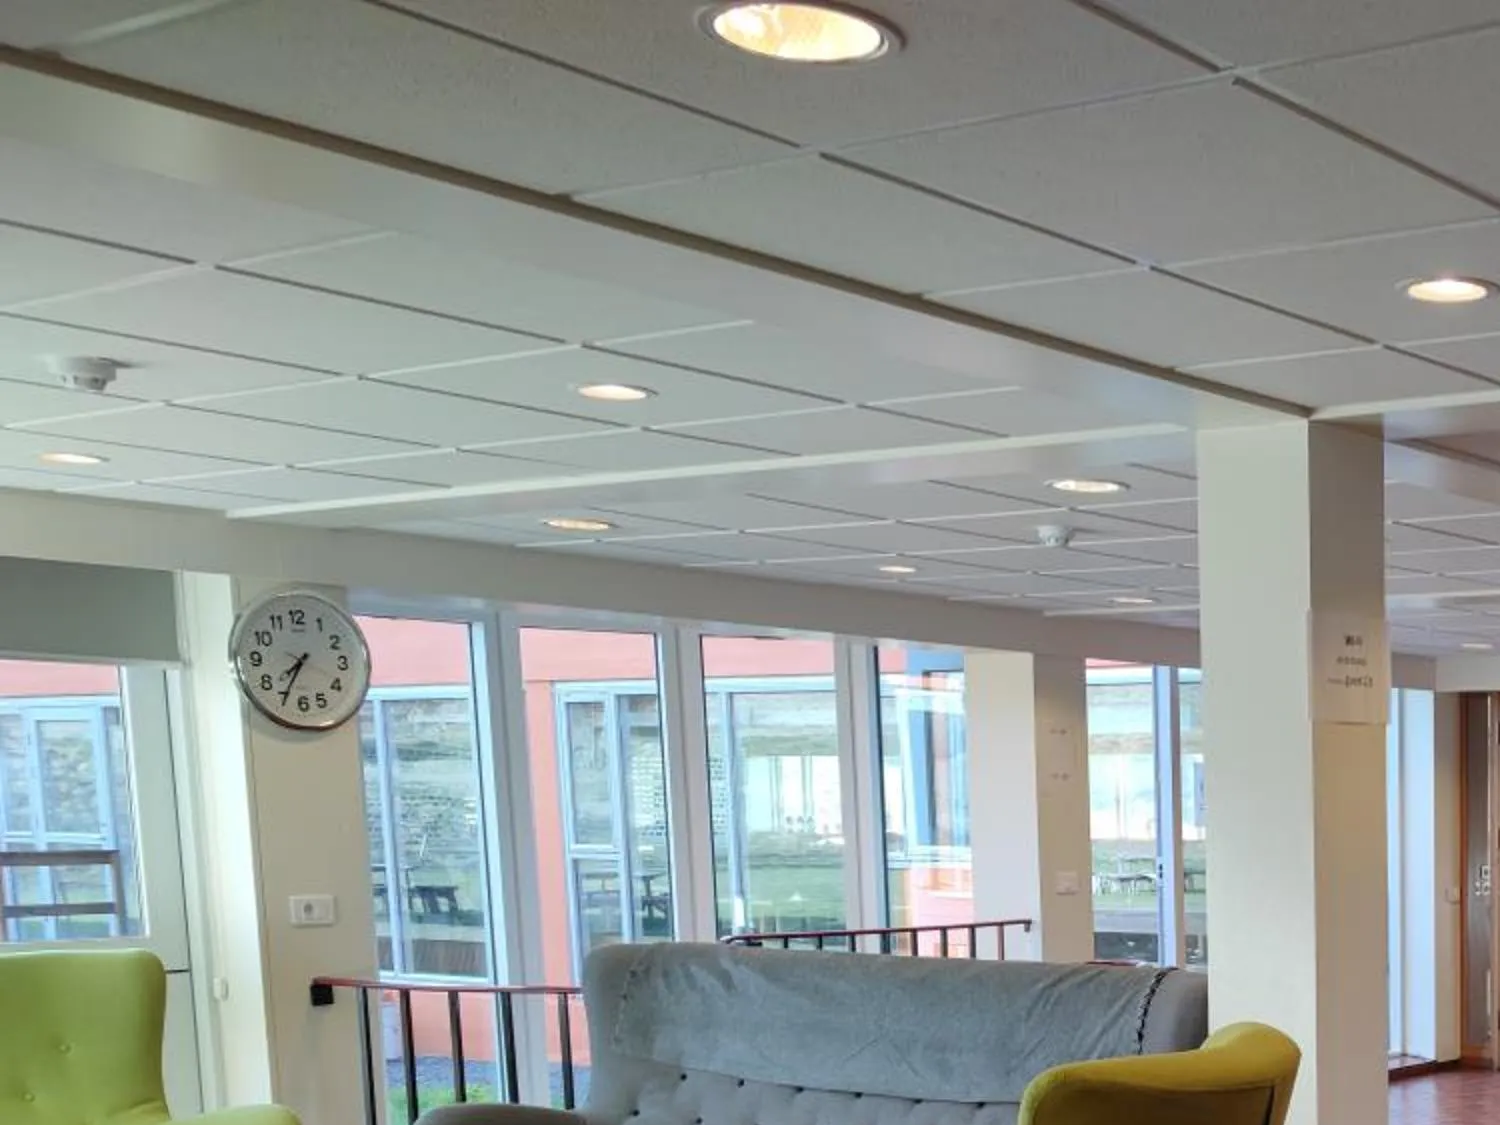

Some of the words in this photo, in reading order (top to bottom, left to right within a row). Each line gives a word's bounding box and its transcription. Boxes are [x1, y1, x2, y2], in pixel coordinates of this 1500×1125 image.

[270, 615, 283, 631] 11
[288, 609, 305, 625] 12
[316, 617, 323, 633] 1
[254, 631, 273, 647] 10
[329, 635, 341, 650] 2
[250, 651, 263, 667] 9
[337, 655, 349, 671] 3
[261, 674, 273, 691] 8
[330, 677, 342, 692] 4
[298, 696, 310, 712] 6
[316, 693, 327, 709] 5
